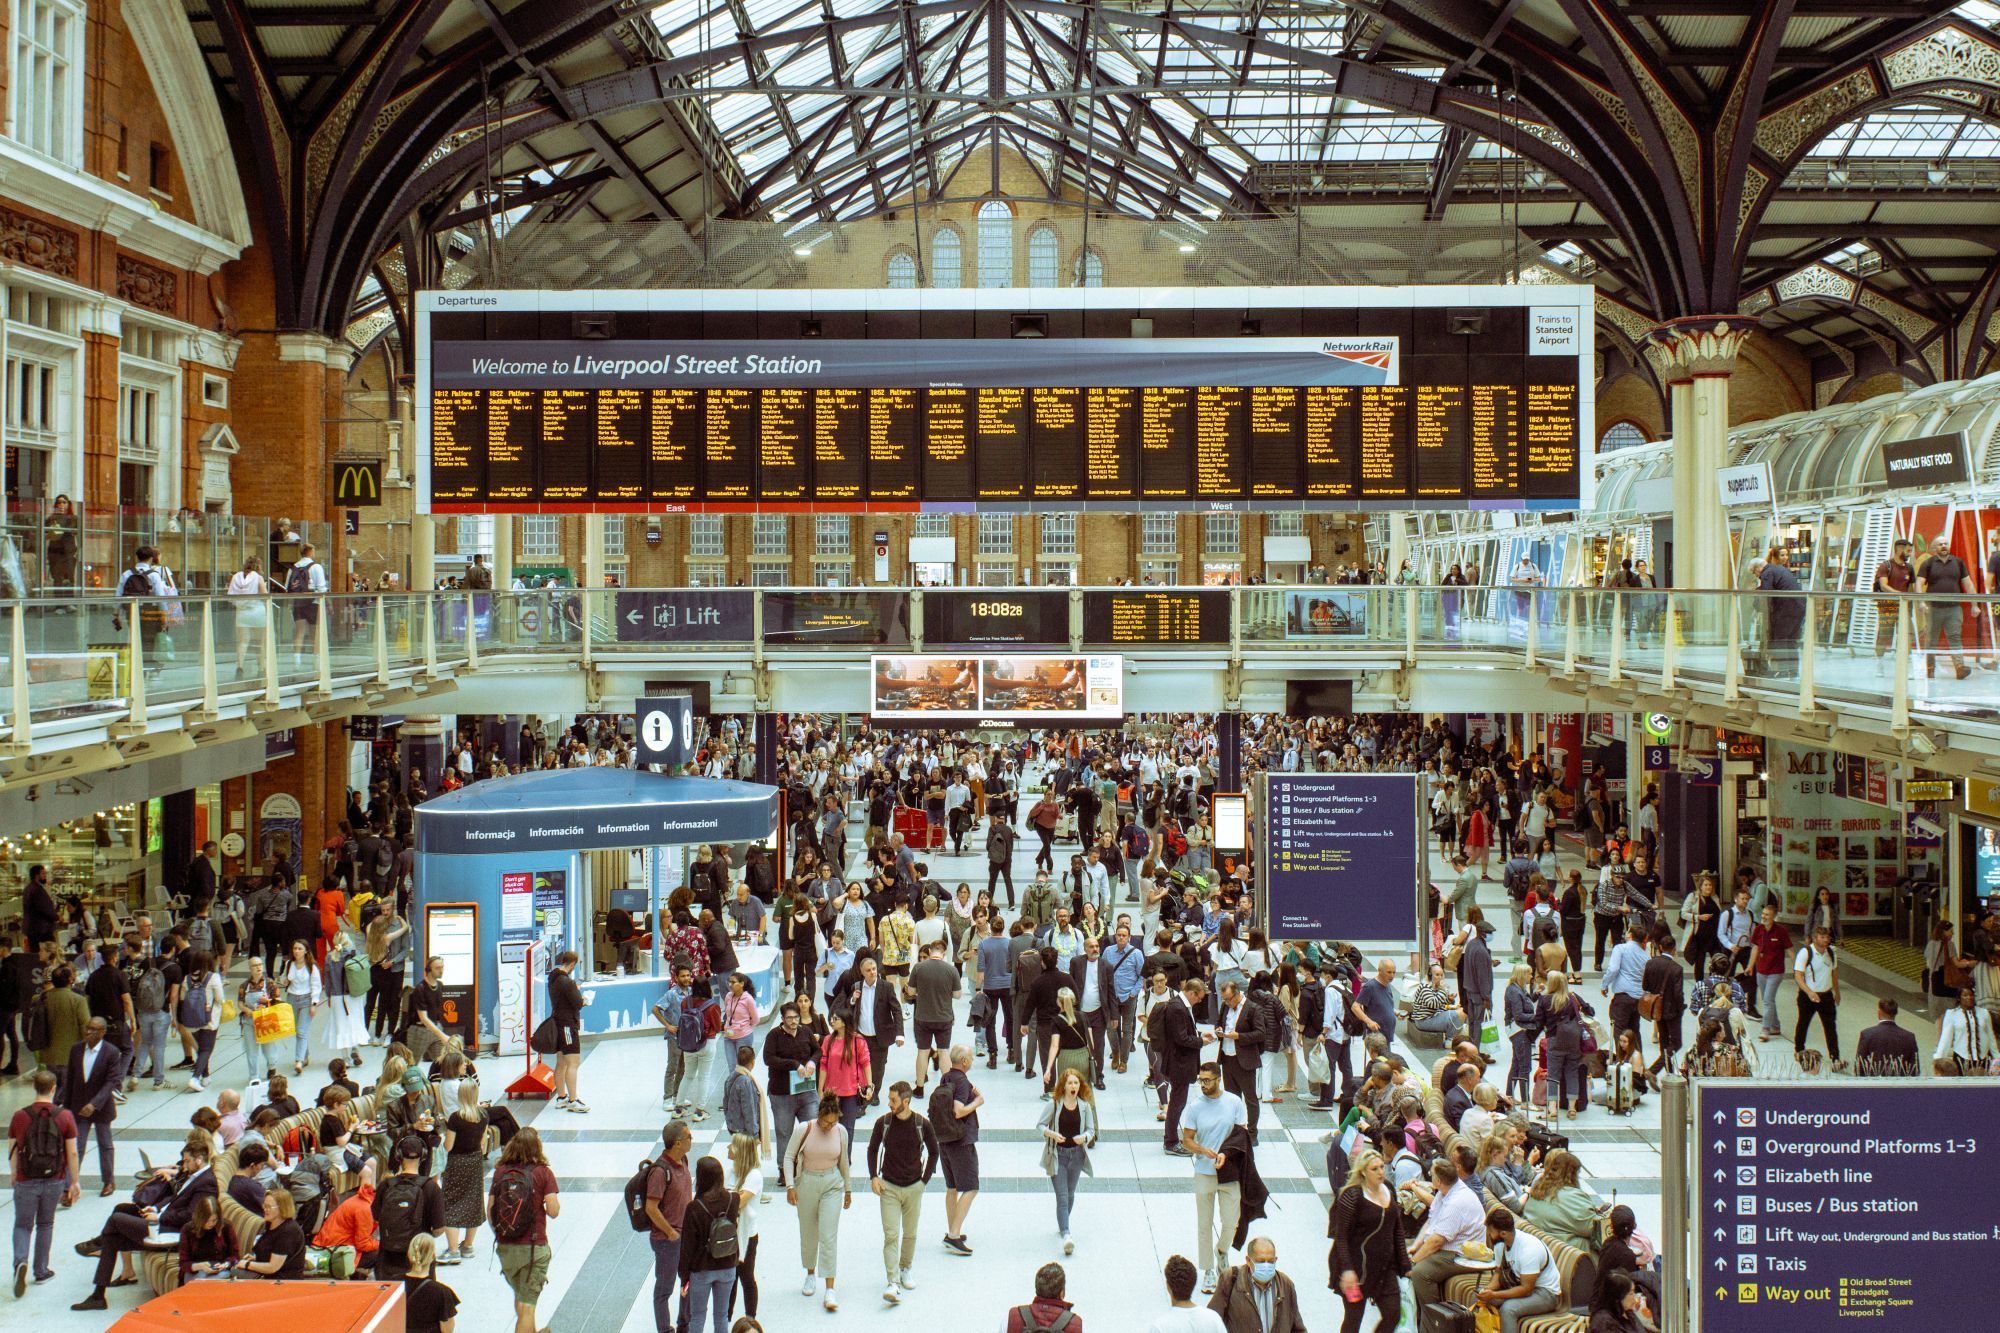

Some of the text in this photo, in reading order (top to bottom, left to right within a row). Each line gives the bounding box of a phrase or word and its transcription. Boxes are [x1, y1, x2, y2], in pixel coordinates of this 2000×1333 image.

[438, 296, 497, 307] Departures
[1536, 326, 1573, 334] Stansted
[1539, 337, 1569, 346] Airport
[1323, 342, 1393, 353] NetworkRail
[473, 355, 821, 379] Welcome to Liverpool Street Station
[1890, 453, 1952, 471] NATURALLY FAST FOOD
[1727, 475, 1759, 496] supercuts
[664, 504, 690, 514] East
[1208, 502, 1236, 512] West
[686, 607, 720, 624] Lift
[979, 719, 1014, 727] JCDecaux
[1738, 735, 1753, 744] MI
[1730, 745, 1761, 754] CASA
[1651, 750, 1663, 765] 8
[1787, 751, 1827, 775] MI
[1293, 784, 1335, 792] Underground
[598, 823, 649, 833] Information
[664, 819, 718, 829] Informazioni
[1804, 818, 1832, 830] COFFEE
[1841, 818, 1881, 832] BURRITOS
[466, 830, 515, 840] Informacja
[530, 826, 584, 837] Información
[1766, 1110, 1870, 1128] Underground
[1766, 1139, 1860, 1157] Overground
[1865, 1139, 1941, 1153] Platforms
[1766, 1168, 1872, 1183] Elizabeth line
[1766, 1198, 1918, 1213] Buses / Bus station
[1766, 1227, 1793, 1241] Lift
[1797, 1232, 1819, 1243] Way
[1844, 1232, 1909, 1243] Underground
[1911, 1231, 1930, 1241] and
[1932, 1231, 1950, 1240] Bus
[1953, 1231, 1987, 1240] station
[1765, 1257, 1806, 1271] Taxis
[1865, 1278, 1887, 1286] Broad
[1889, 1278, 1912, 1286] Street
[1766, 1286, 1800, 1302] Way
[1804, 1287, 1831, 1300] out
[1851, 1289, 1889, 1297] Broadgate
[1851, 1298, 1913, 1307] Exchange Square
[1839, 1309, 1874, 1317] Liverpool
